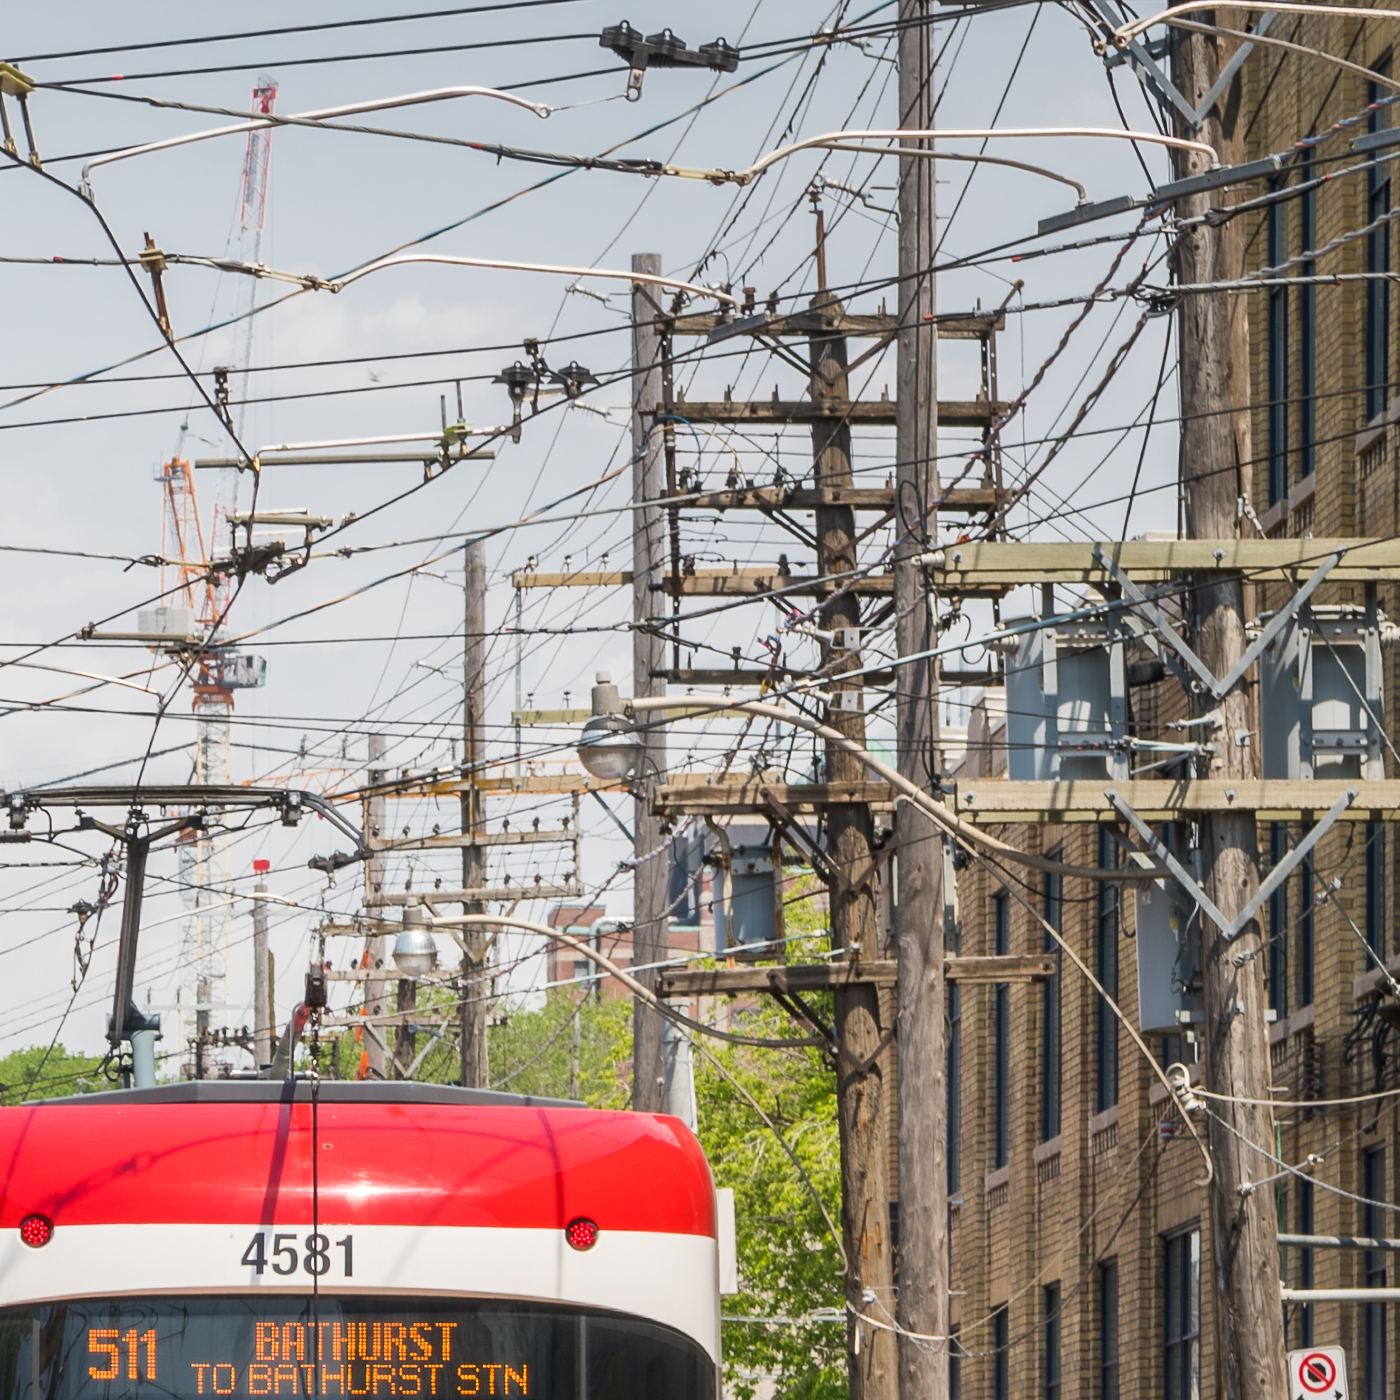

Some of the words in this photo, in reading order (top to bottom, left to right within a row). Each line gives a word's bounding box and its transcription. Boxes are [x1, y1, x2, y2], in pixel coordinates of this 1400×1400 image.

[240, 1233, 354, 1278] 4581
[88, 1329, 157, 1380] 511
[255, 1322, 458, 1361] BATHURST
[191, 1364, 236, 1395] TO
[248, 1364, 444, 1395] BATHURST
[457, 1364, 528, 1395] STN
